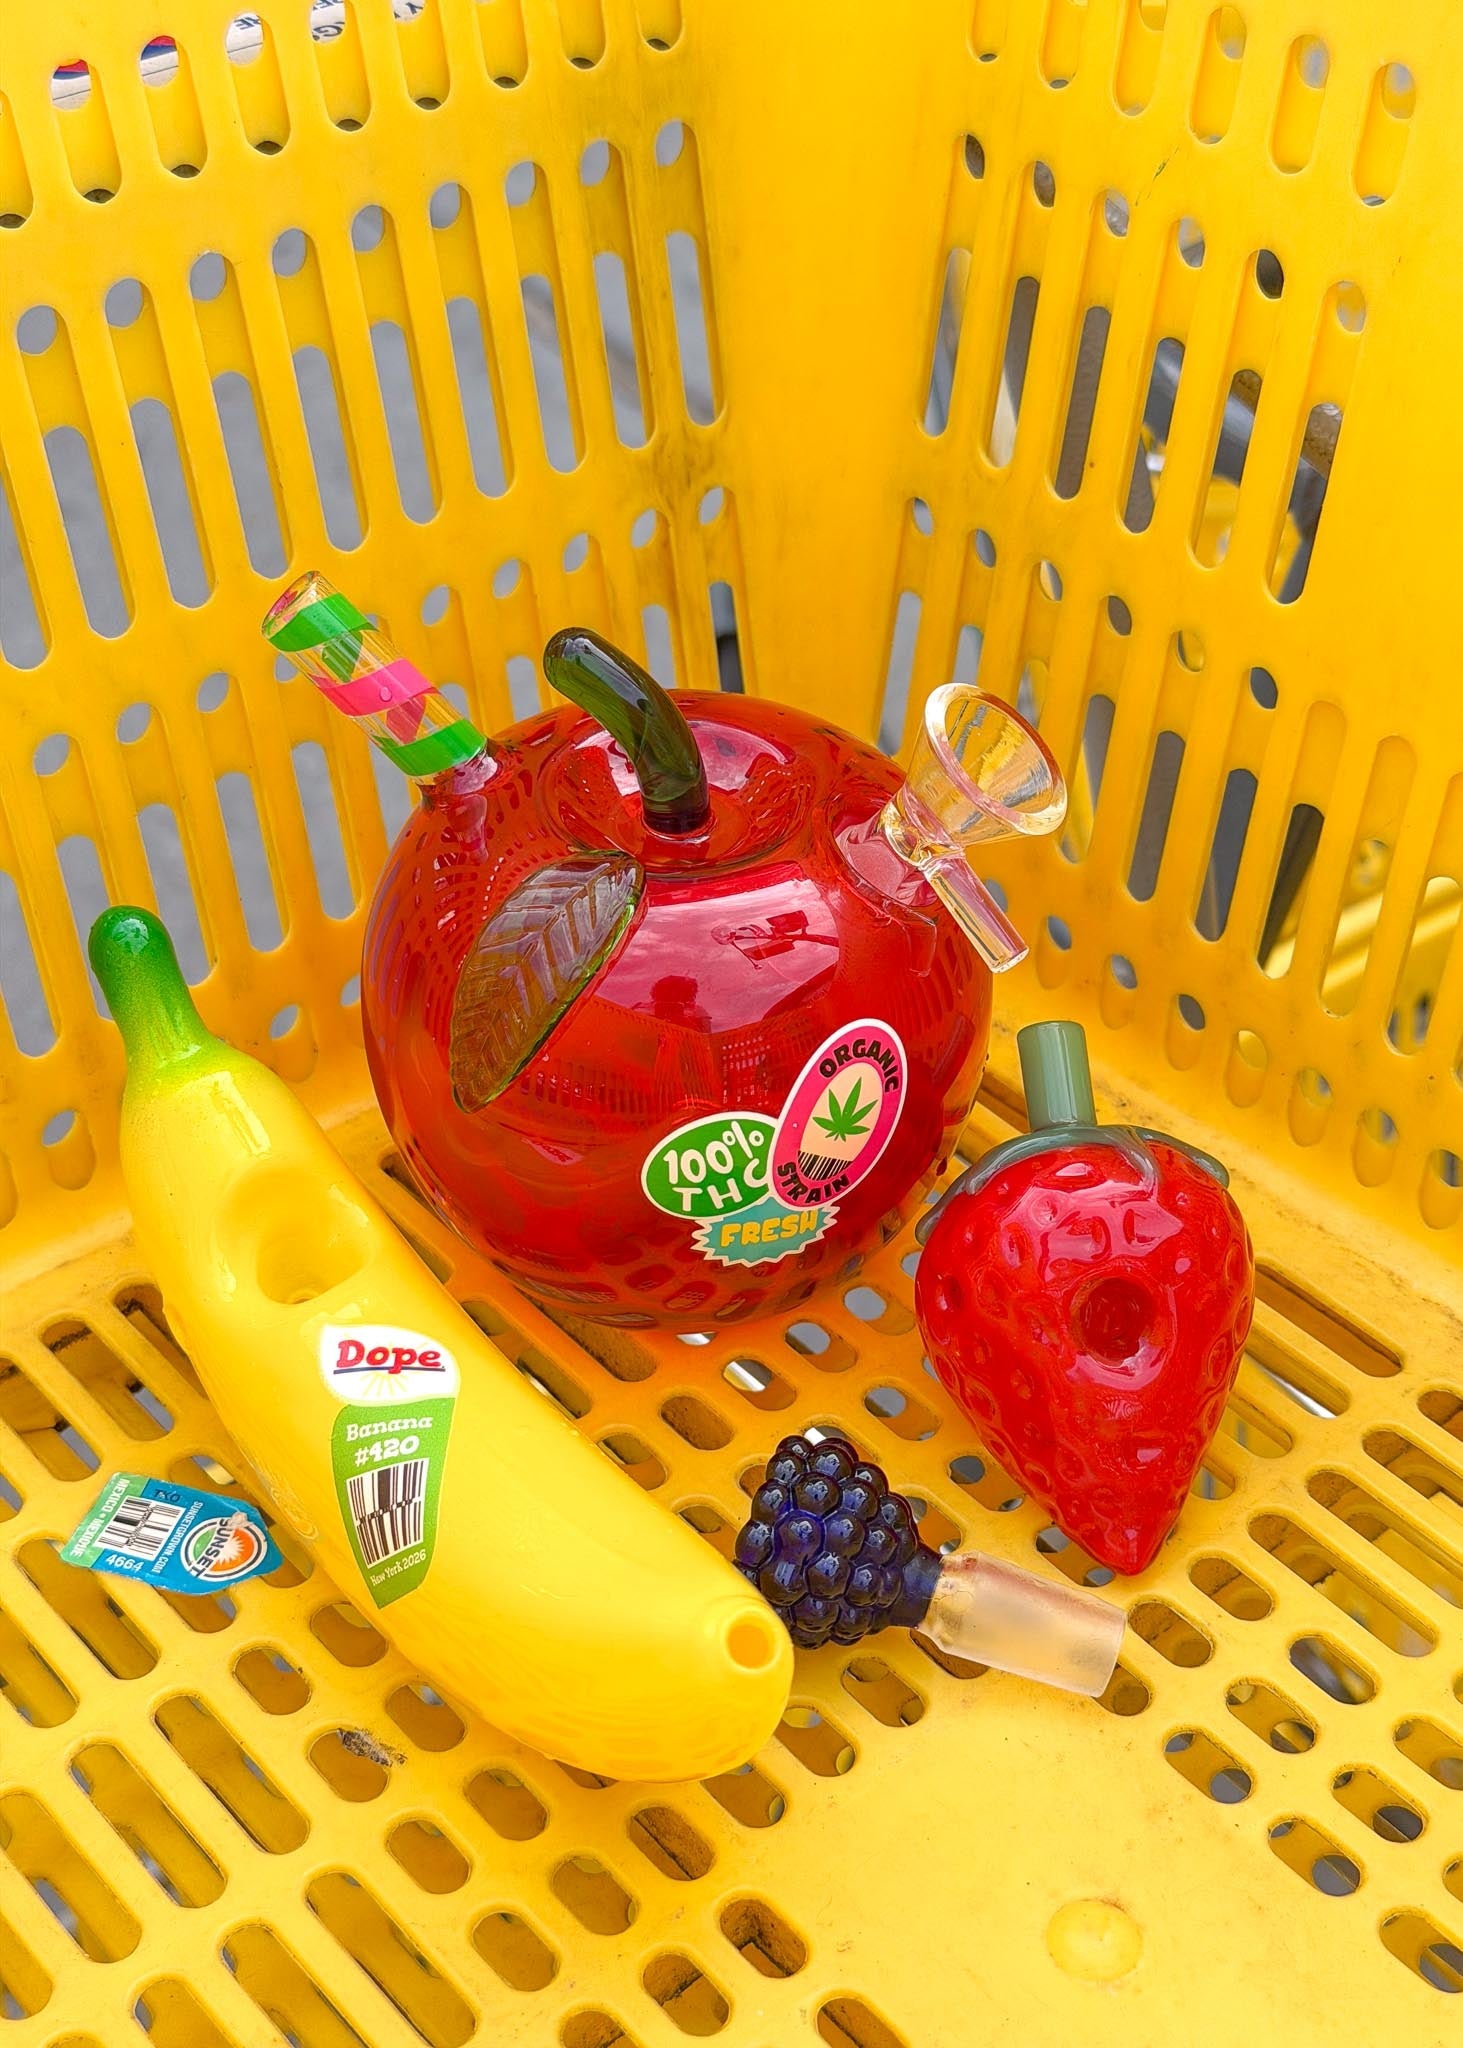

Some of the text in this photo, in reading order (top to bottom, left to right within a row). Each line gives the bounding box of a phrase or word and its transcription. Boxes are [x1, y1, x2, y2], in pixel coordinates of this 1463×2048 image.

[819, 1038, 899, 1093] ORGANIC
[663, 1120, 765, 1185] 100%
[672, 1158, 769, 1212] THC
[777, 1161, 851, 1204] STRAIN
[720, 1209, 819, 1248] FRESH
[336, 1339, 442, 1374] Dope
[346, 1416, 434, 1442] Banana
[354, 1435, 420, 1468] #420
[102, 1478, 130, 1512] MEXICO
[151, 1501, 204, 1574] SUNSETGROWN.COM
[189, 1518, 233, 1579] SUNSET
[105, 1553, 145, 1573] 4664
[370, 1548, 427, 1586] New York 2026
